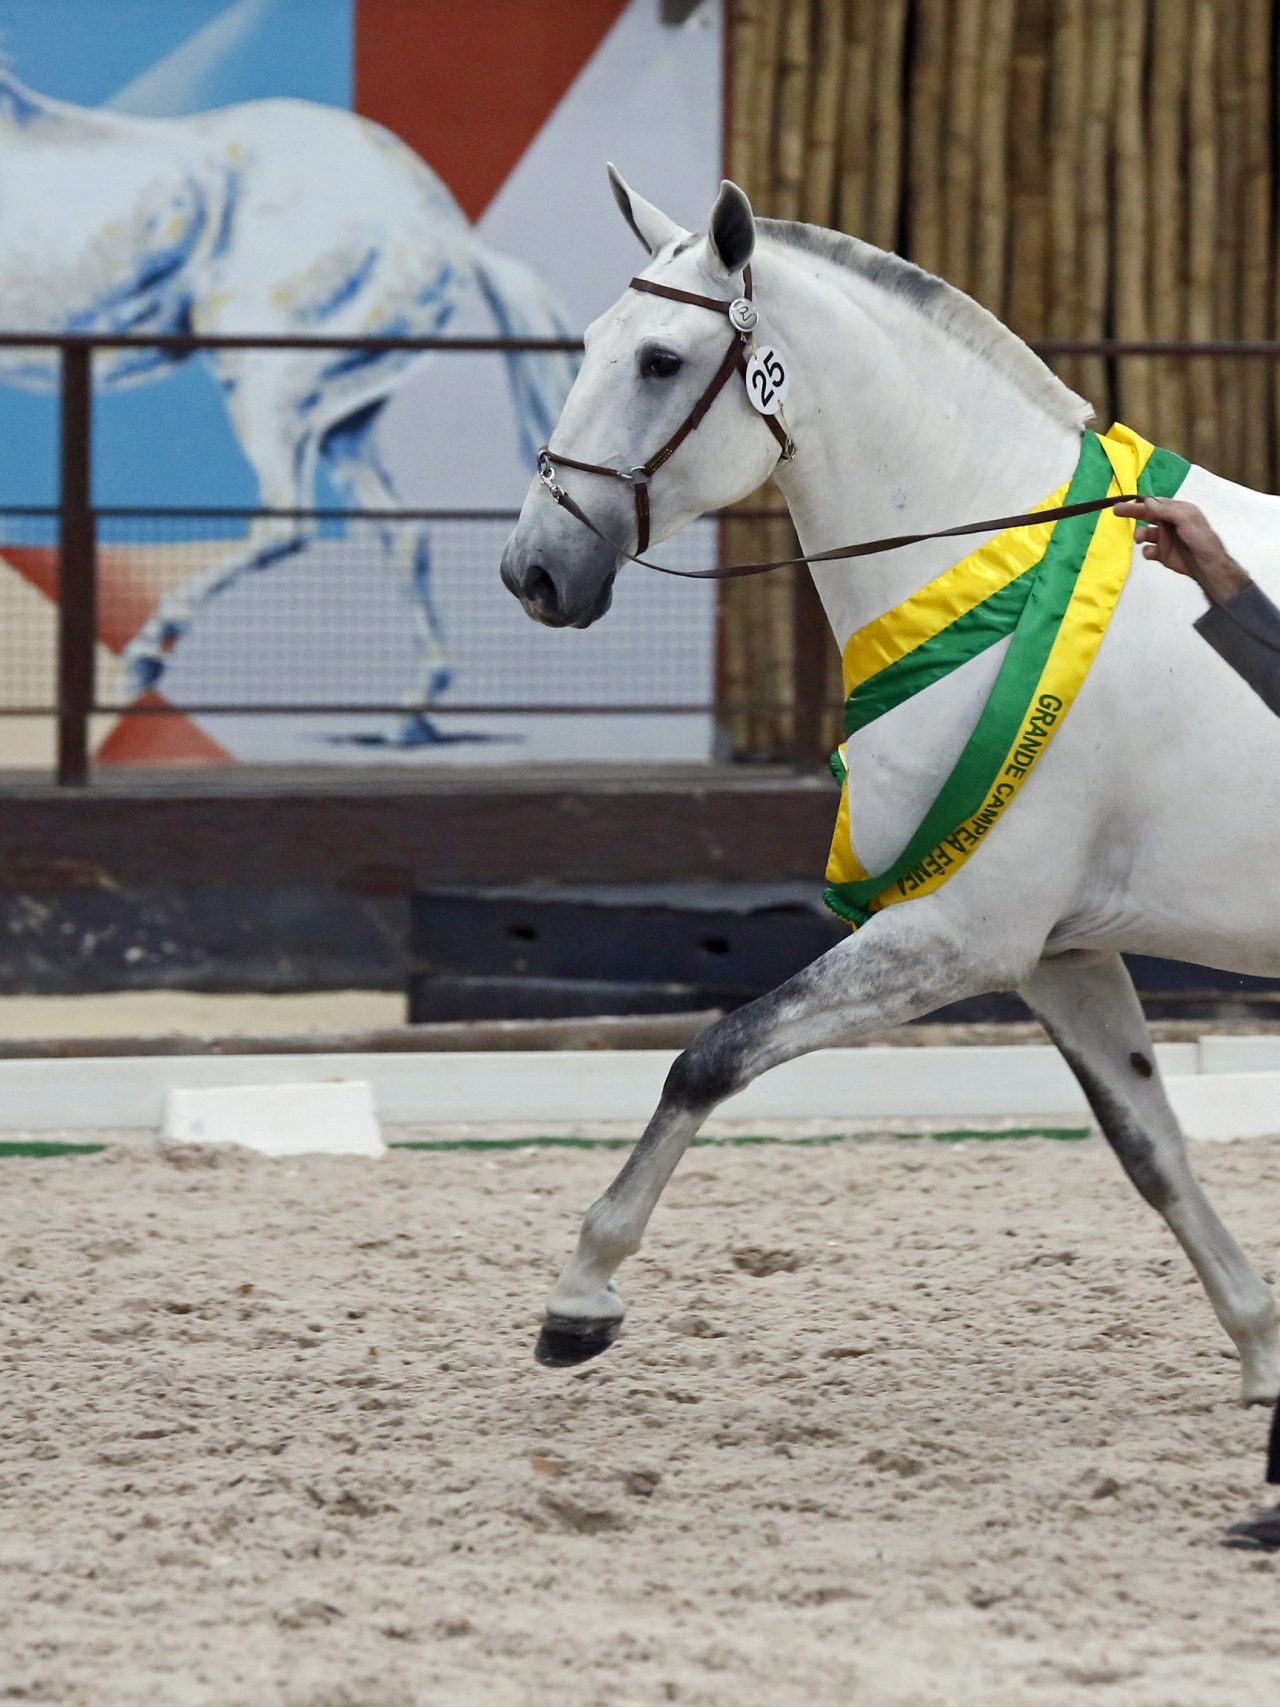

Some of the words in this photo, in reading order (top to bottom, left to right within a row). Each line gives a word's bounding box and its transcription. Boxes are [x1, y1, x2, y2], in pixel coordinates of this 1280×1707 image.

[752, 351, 785, 408] 25
[1005, 693, 1063, 780] GRANDE
[944, 783, 1015, 855] CAMPEÃ
